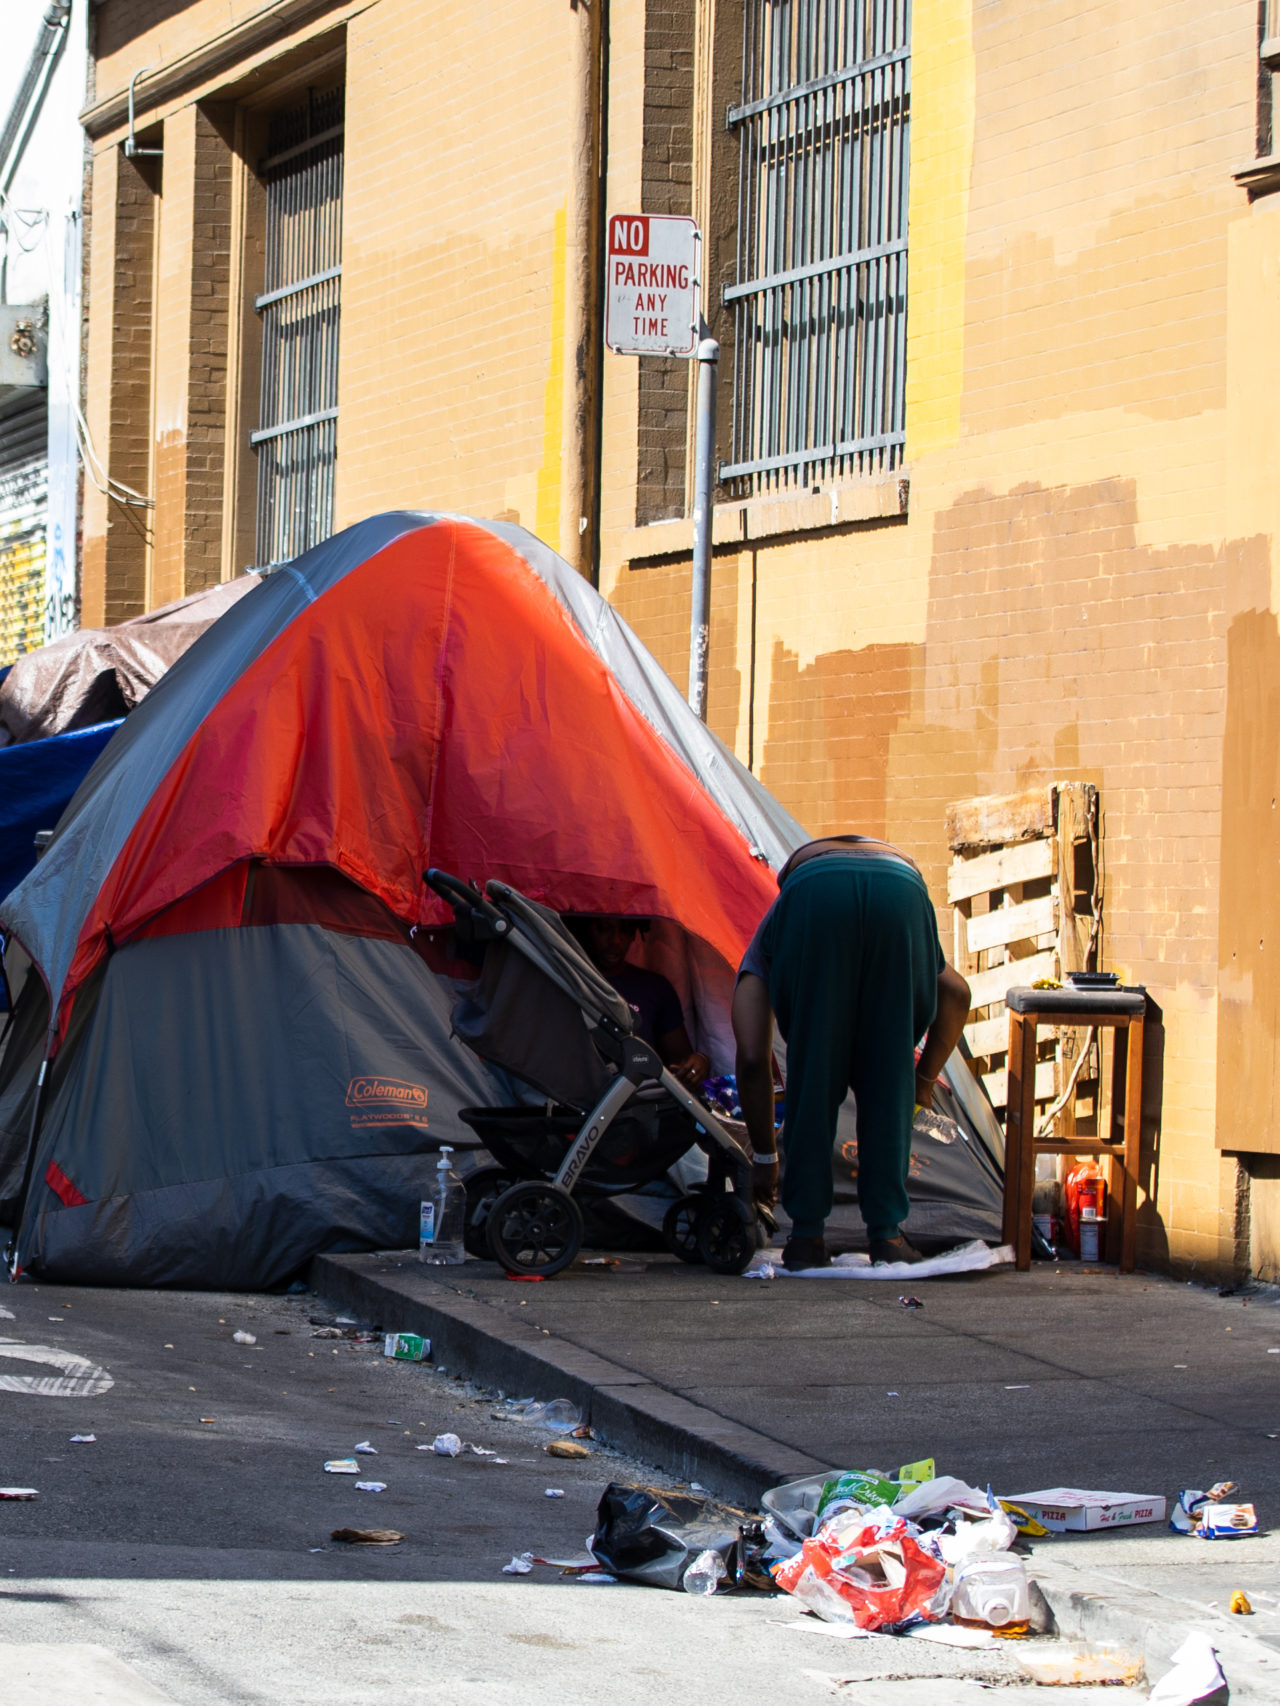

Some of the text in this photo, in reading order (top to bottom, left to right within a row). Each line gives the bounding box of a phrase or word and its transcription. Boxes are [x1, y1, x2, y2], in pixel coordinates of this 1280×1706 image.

[614, 220, 644, 251] NO
[615, 261, 689, 290] PARKING
[635, 293, 668, 313] ANY
[633, 317, 669, 337] TIME
[353, 1080, 412, 1099] Coleman
[561, 1126, 599, 1188] BRAVO
[1041, 1510, 1066, 1521] PIZZA
[1134, 1508, 1153, 1519] PIZZA
